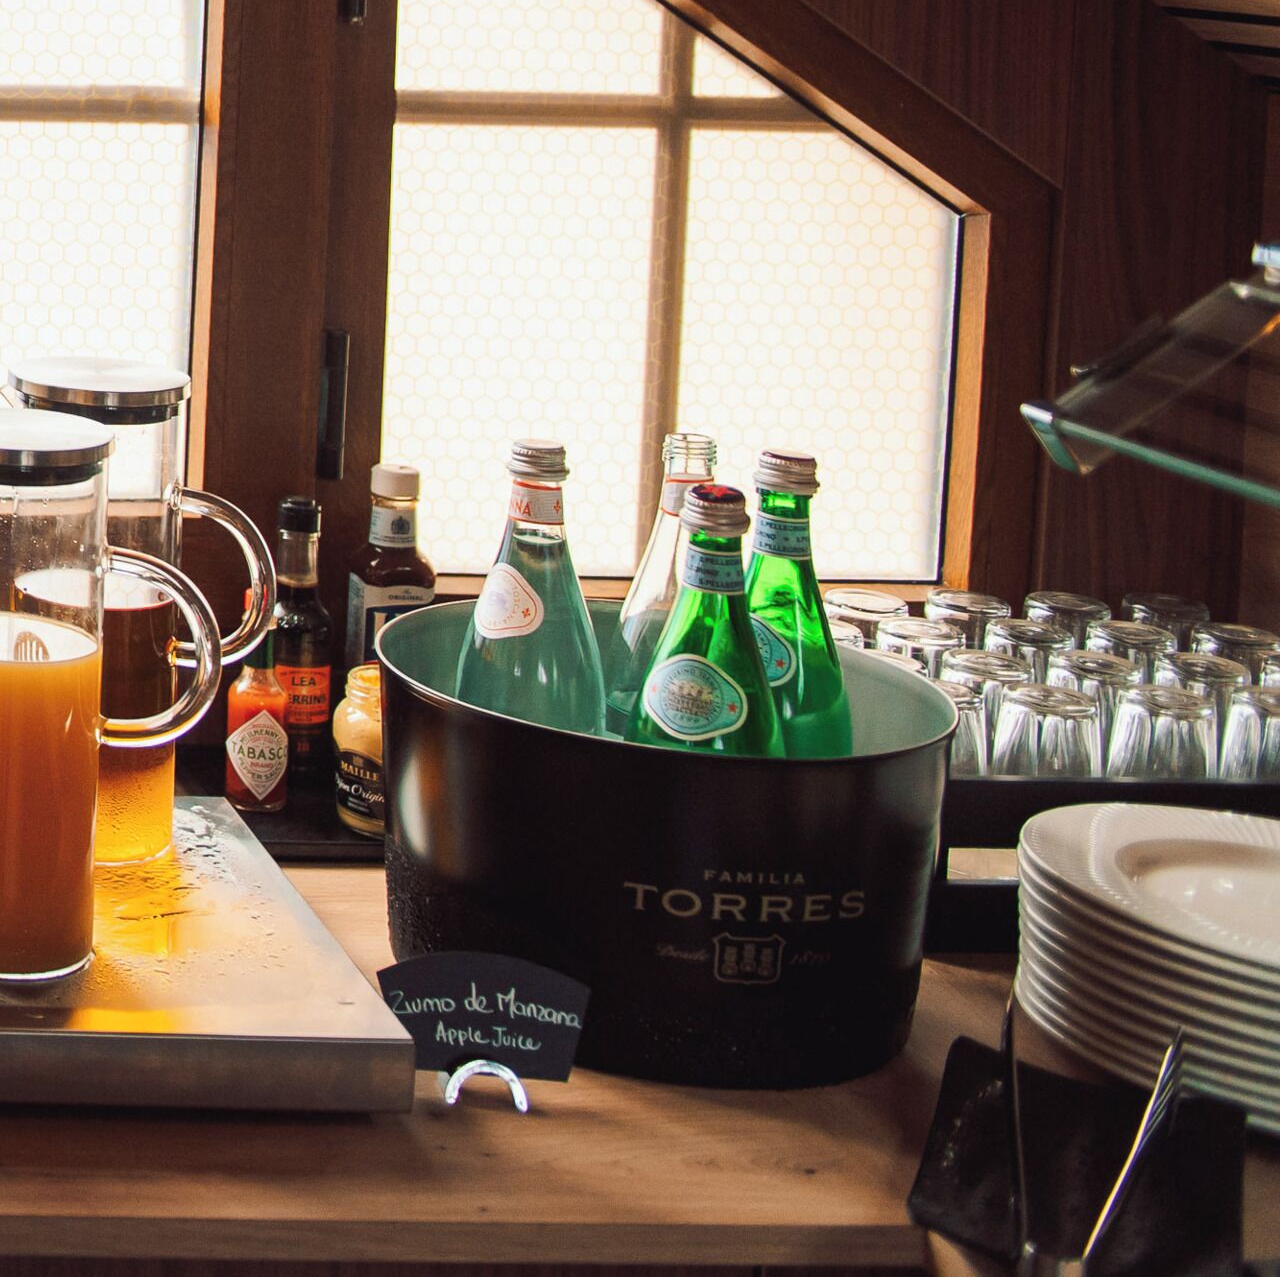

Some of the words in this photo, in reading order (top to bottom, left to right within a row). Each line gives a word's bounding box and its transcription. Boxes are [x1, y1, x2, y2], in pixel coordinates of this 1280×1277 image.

[292, 676, 317, 687] LEA
[341, 761, 379, 781] MAILLE
[703, 869, 806, 885] FAMILIA
[623, 881, 866, 923] TORRES
[390, 990, 456, 1015] Zumo
[464, 982, 494, 1013] de
[496, 987, 582, 1029] Manzana
[435, 1020, 490, 1047] Apple
[492, 1026, 542, 1051] Juice
